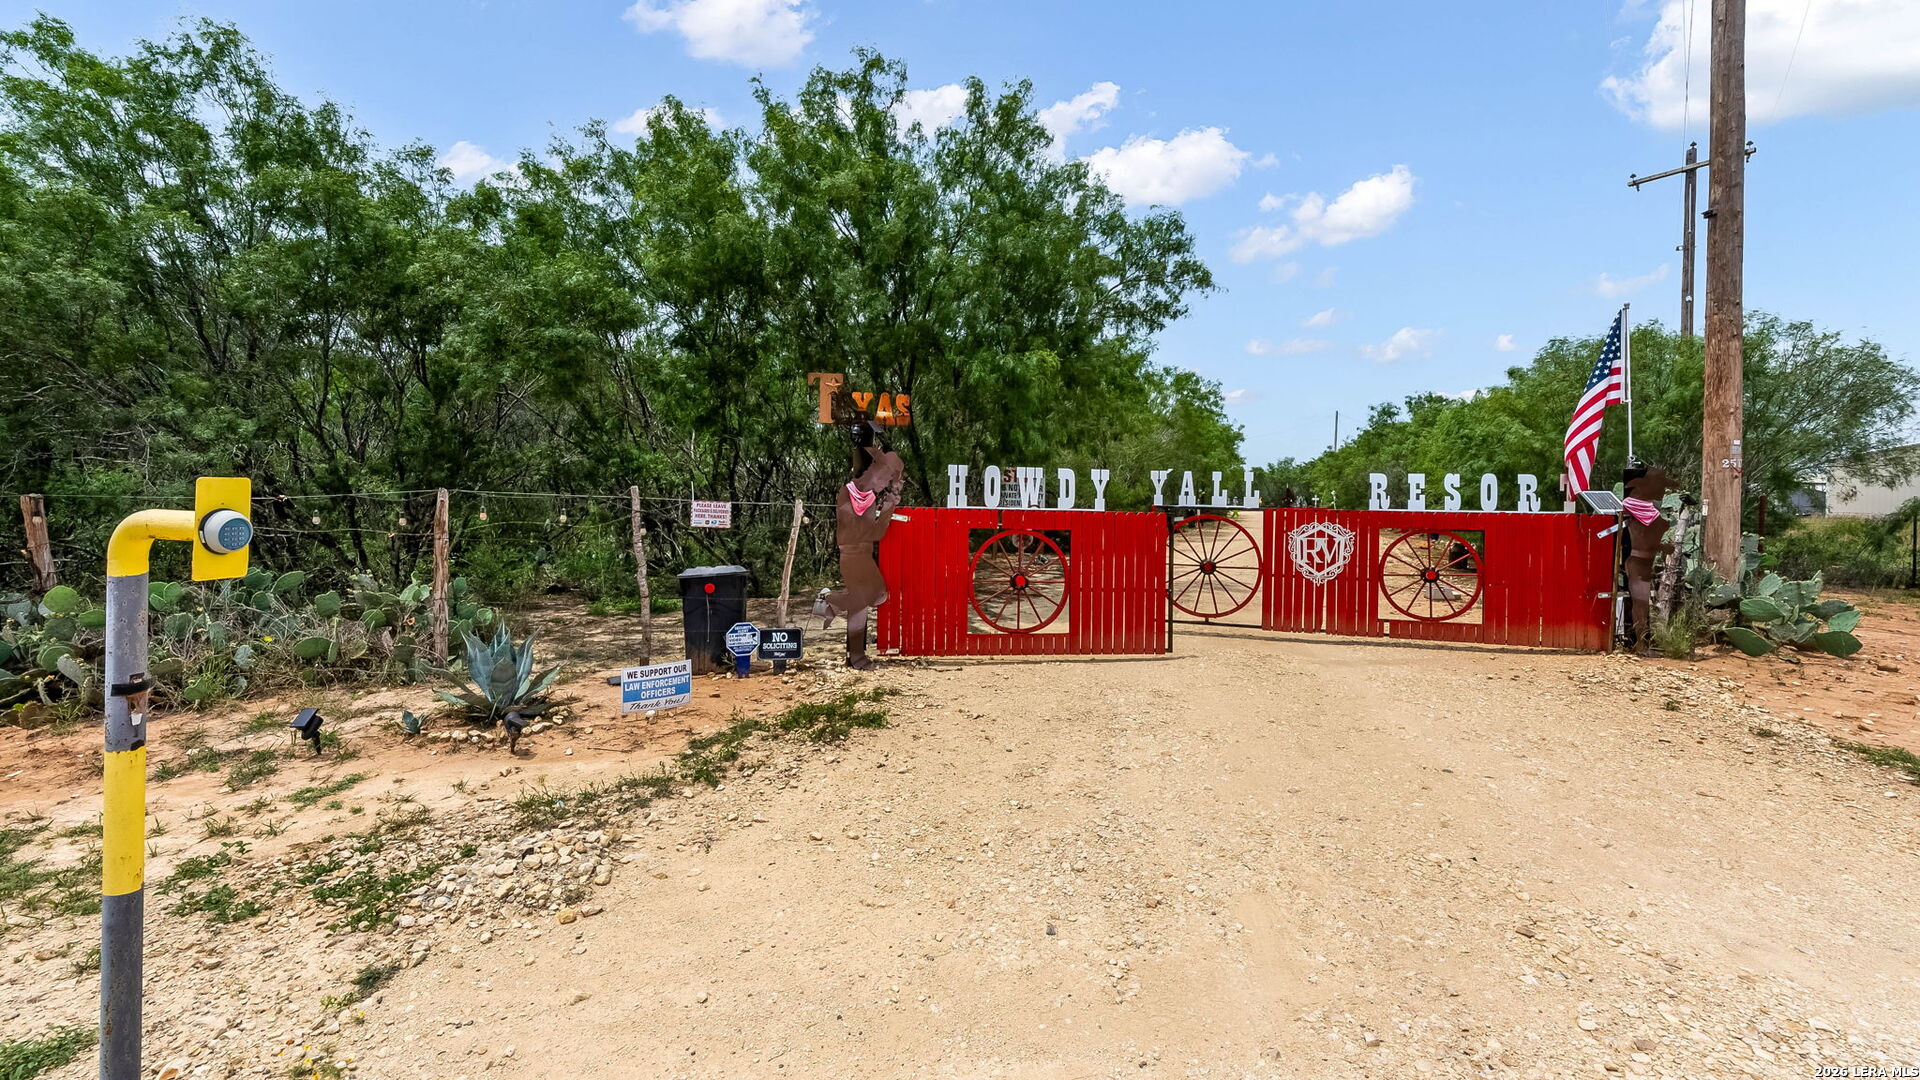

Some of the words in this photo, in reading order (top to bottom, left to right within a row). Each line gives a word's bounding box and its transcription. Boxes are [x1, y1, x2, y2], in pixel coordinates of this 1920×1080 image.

[947, 465, 1110, 511] HOWDY
[772, 632, 788, 643] NO
[762, 642, 798, 650] SOLICITING
[626, 671, 638, 679] WE
[640, 666, 672, 678] SUPPORT
[673, 664, 687, 674] OUR
[624, 682, 640, 692] LAW
[641, 674, 690, 690] ENFORCEMENT
[640, 686, 676, 699] OFFICERS
[629, 700, 662, 711] Thank
[664, 695, 686, 706] You!
